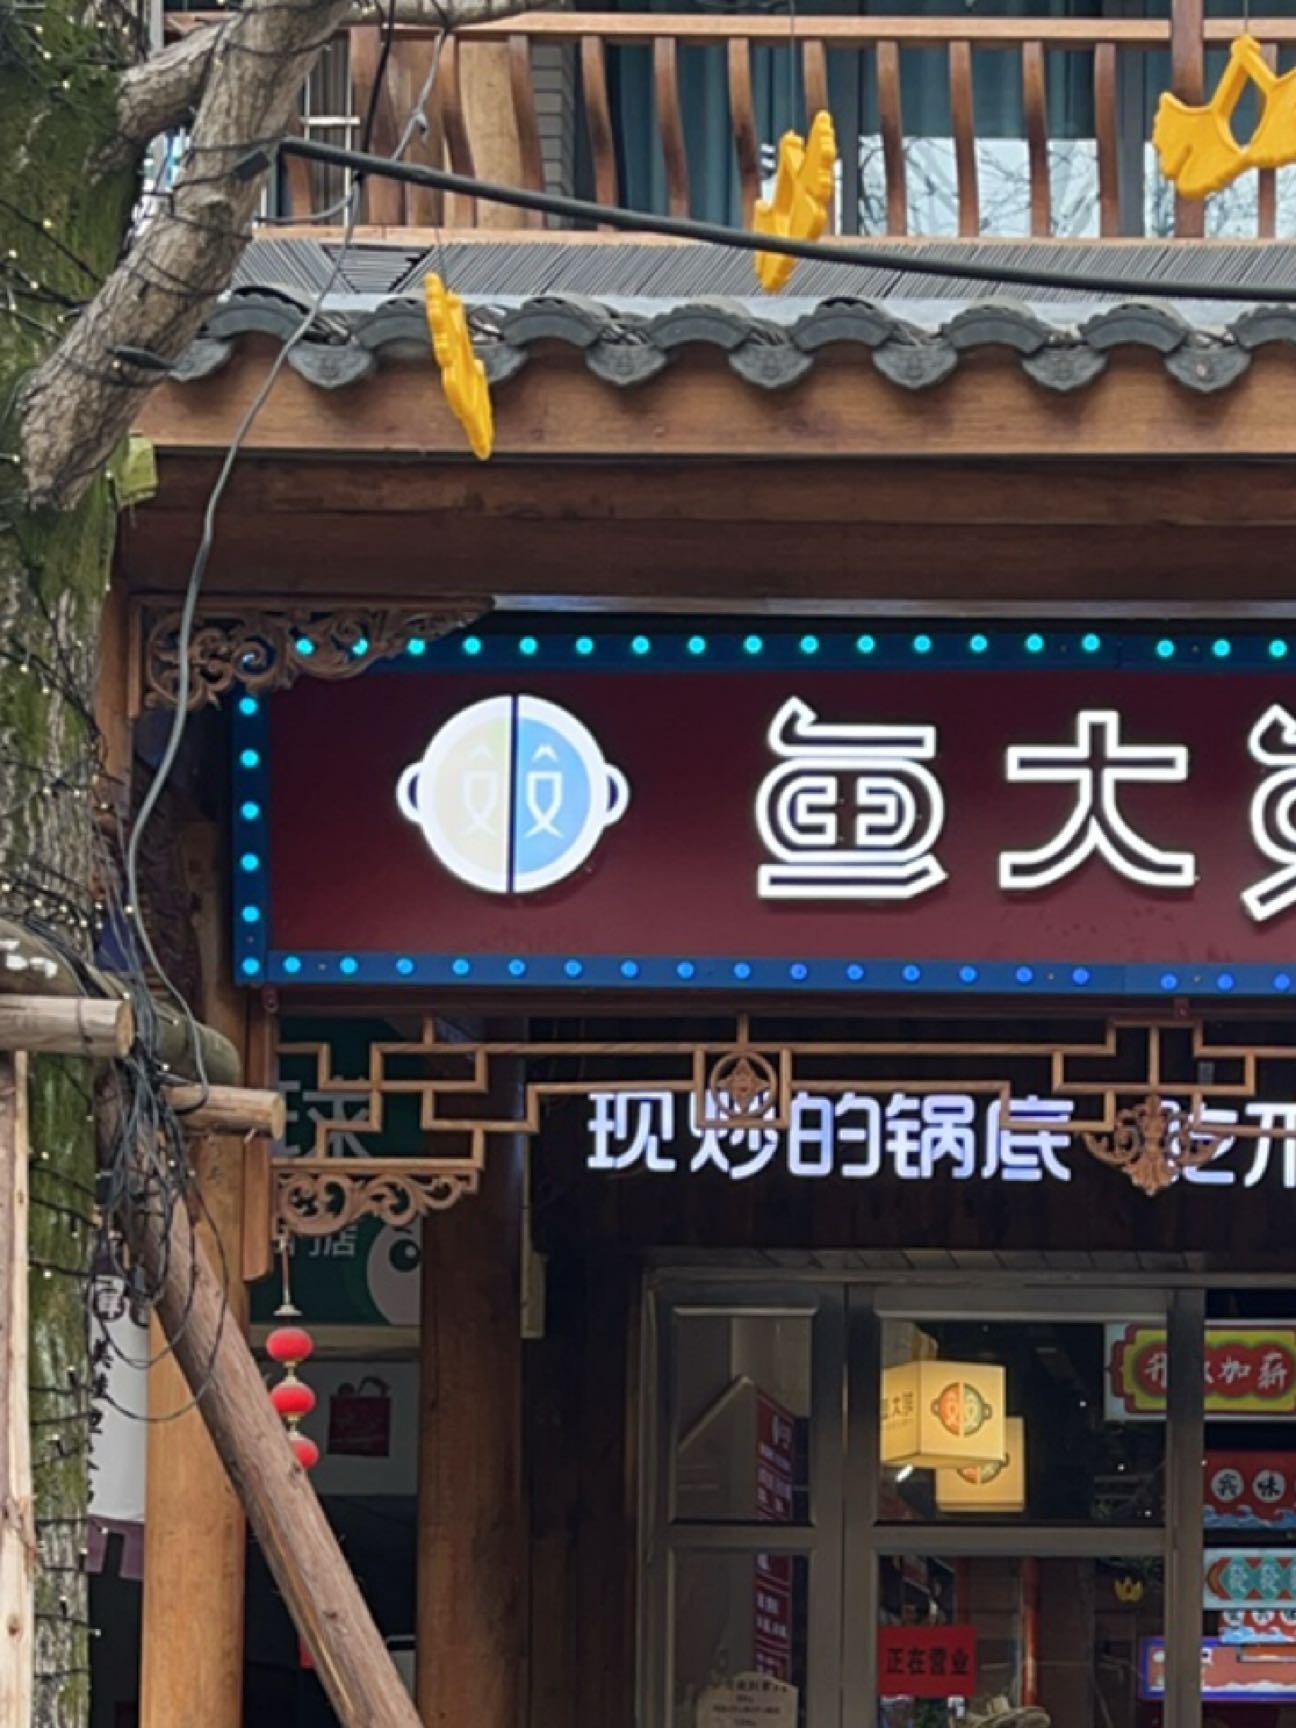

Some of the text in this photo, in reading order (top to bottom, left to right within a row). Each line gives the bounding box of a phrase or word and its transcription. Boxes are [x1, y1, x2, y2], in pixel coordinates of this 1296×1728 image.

[586, 1091, 1074, 1182] 现炒的锅底
[1144, 1349, 1289, 1391] 升加薪
[885, 1647, 969, 1675] 正在营业
